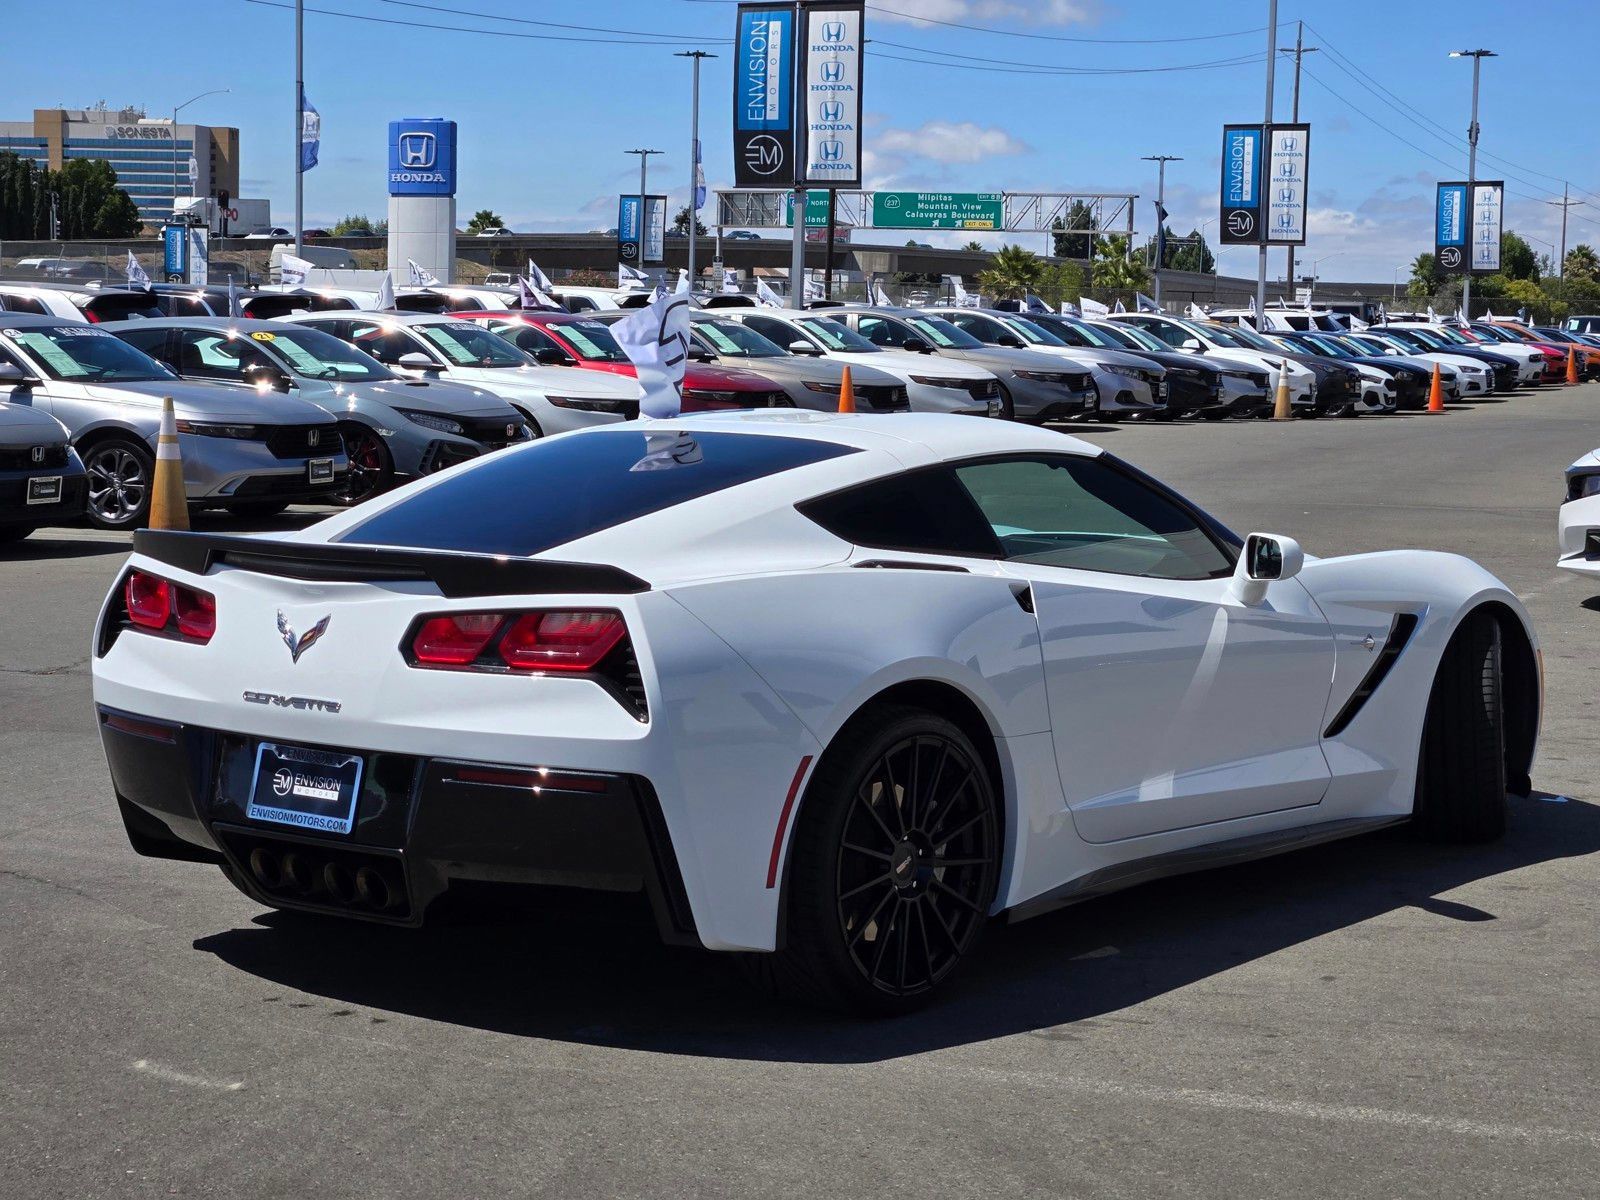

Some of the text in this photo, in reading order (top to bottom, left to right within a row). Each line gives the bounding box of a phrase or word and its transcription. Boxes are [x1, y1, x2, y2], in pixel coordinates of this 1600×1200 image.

[748, 21, 768, 120] ENVISION
[769, 30, 779, 112] MOTORS
[118, 126, 172, 139] SONESTA
[390, 173, 446, 182] HONDA
[1230, 136, 1244, 202] ENVISION
[918, 194, 952, 202] Milpitas
[1442, 190, 1453, 240] ENVISION
[242, 690, 342, 714] CORVETTE
[294, 773, 342, 792] ENVISION
[250, 807, 348, 832] ENVISIONMOTORS.COM
